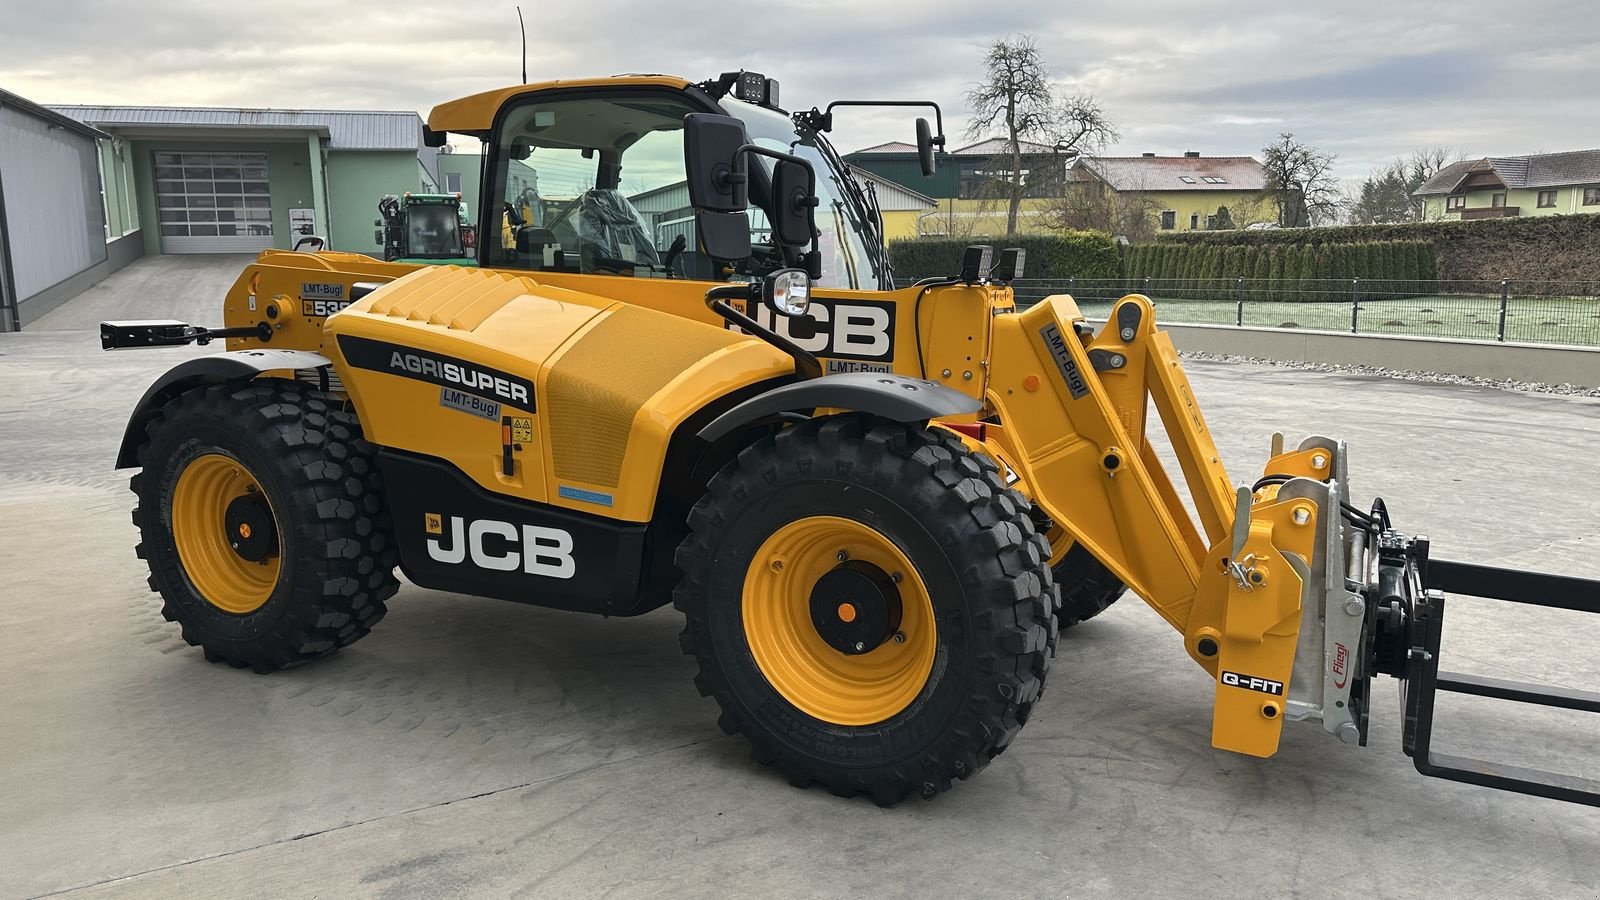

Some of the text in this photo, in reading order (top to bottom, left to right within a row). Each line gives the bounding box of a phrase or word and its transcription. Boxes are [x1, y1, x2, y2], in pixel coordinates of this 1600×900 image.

[303, 283, 343, 297] LMT-Bugl
[1046, 327, 1087, 393] LMT-Bugl
[390, 351, 528, 404] AGRISUPER
[443, 388, 498, 417] LMT-Bugl
[427, 516, 576, 579] JCB
[1332, 642, 1348, 675] Fliegl
[1223, 672, 1282, 693] Q-FIT
